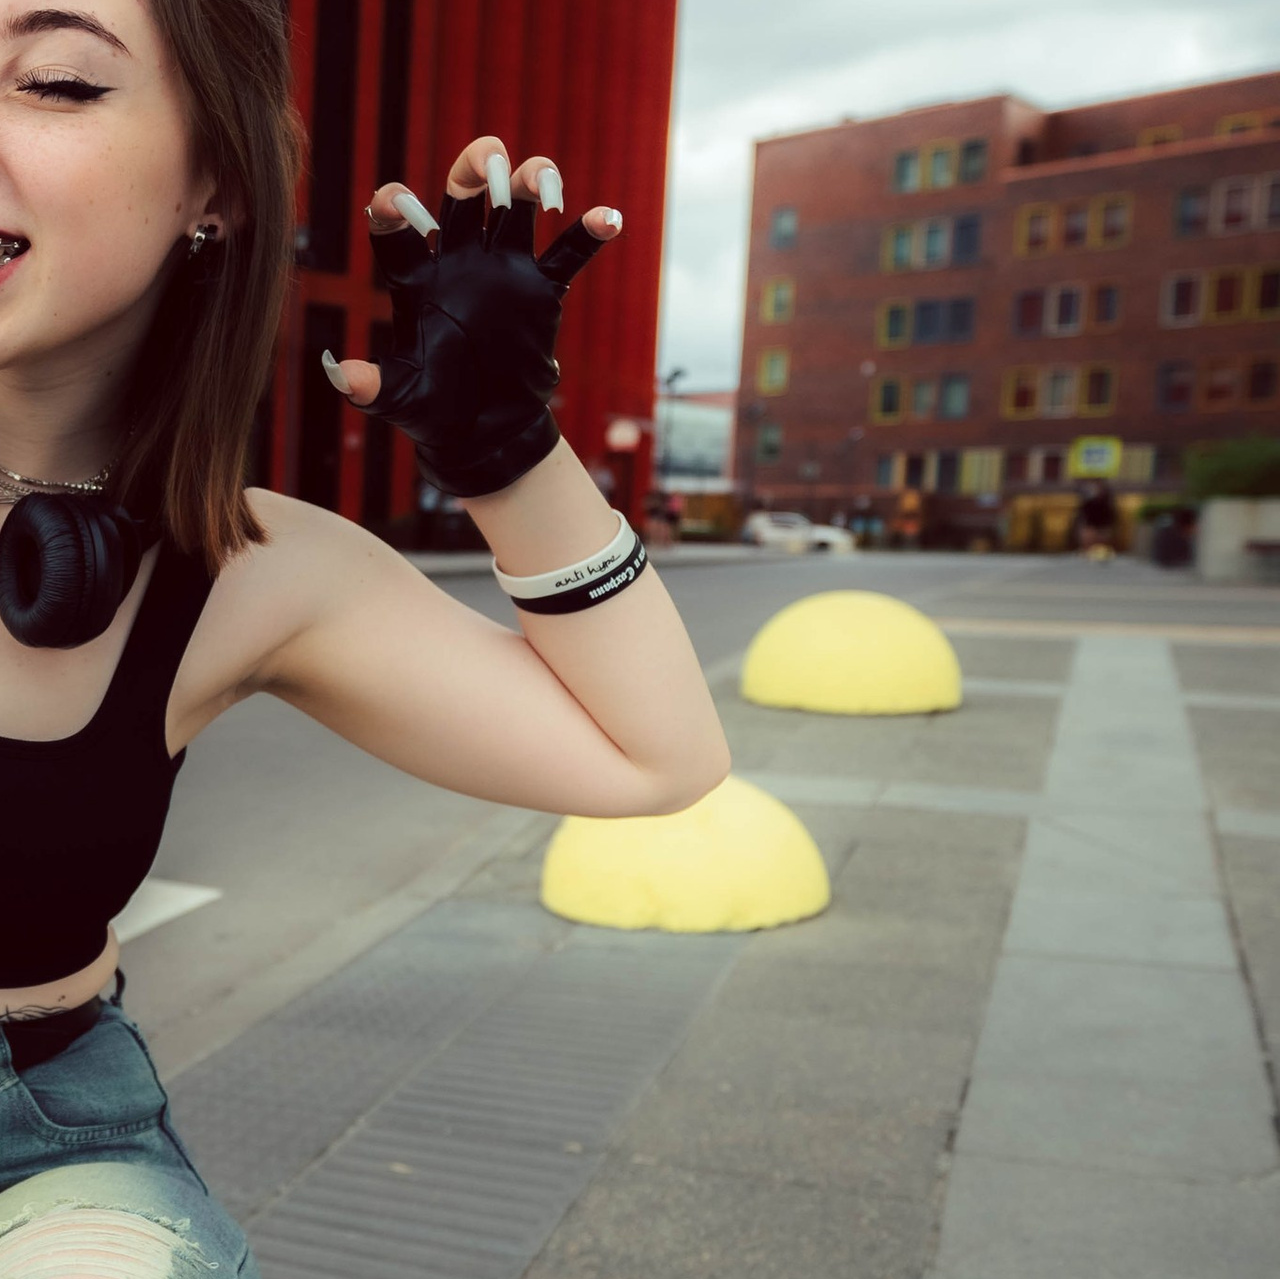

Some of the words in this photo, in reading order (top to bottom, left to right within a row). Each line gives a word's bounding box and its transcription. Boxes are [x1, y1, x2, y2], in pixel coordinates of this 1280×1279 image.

[555, 570, 585, 588] anti
[587, 554, 622, 576] hype
[588, 566, 635, 599] Сохрани
